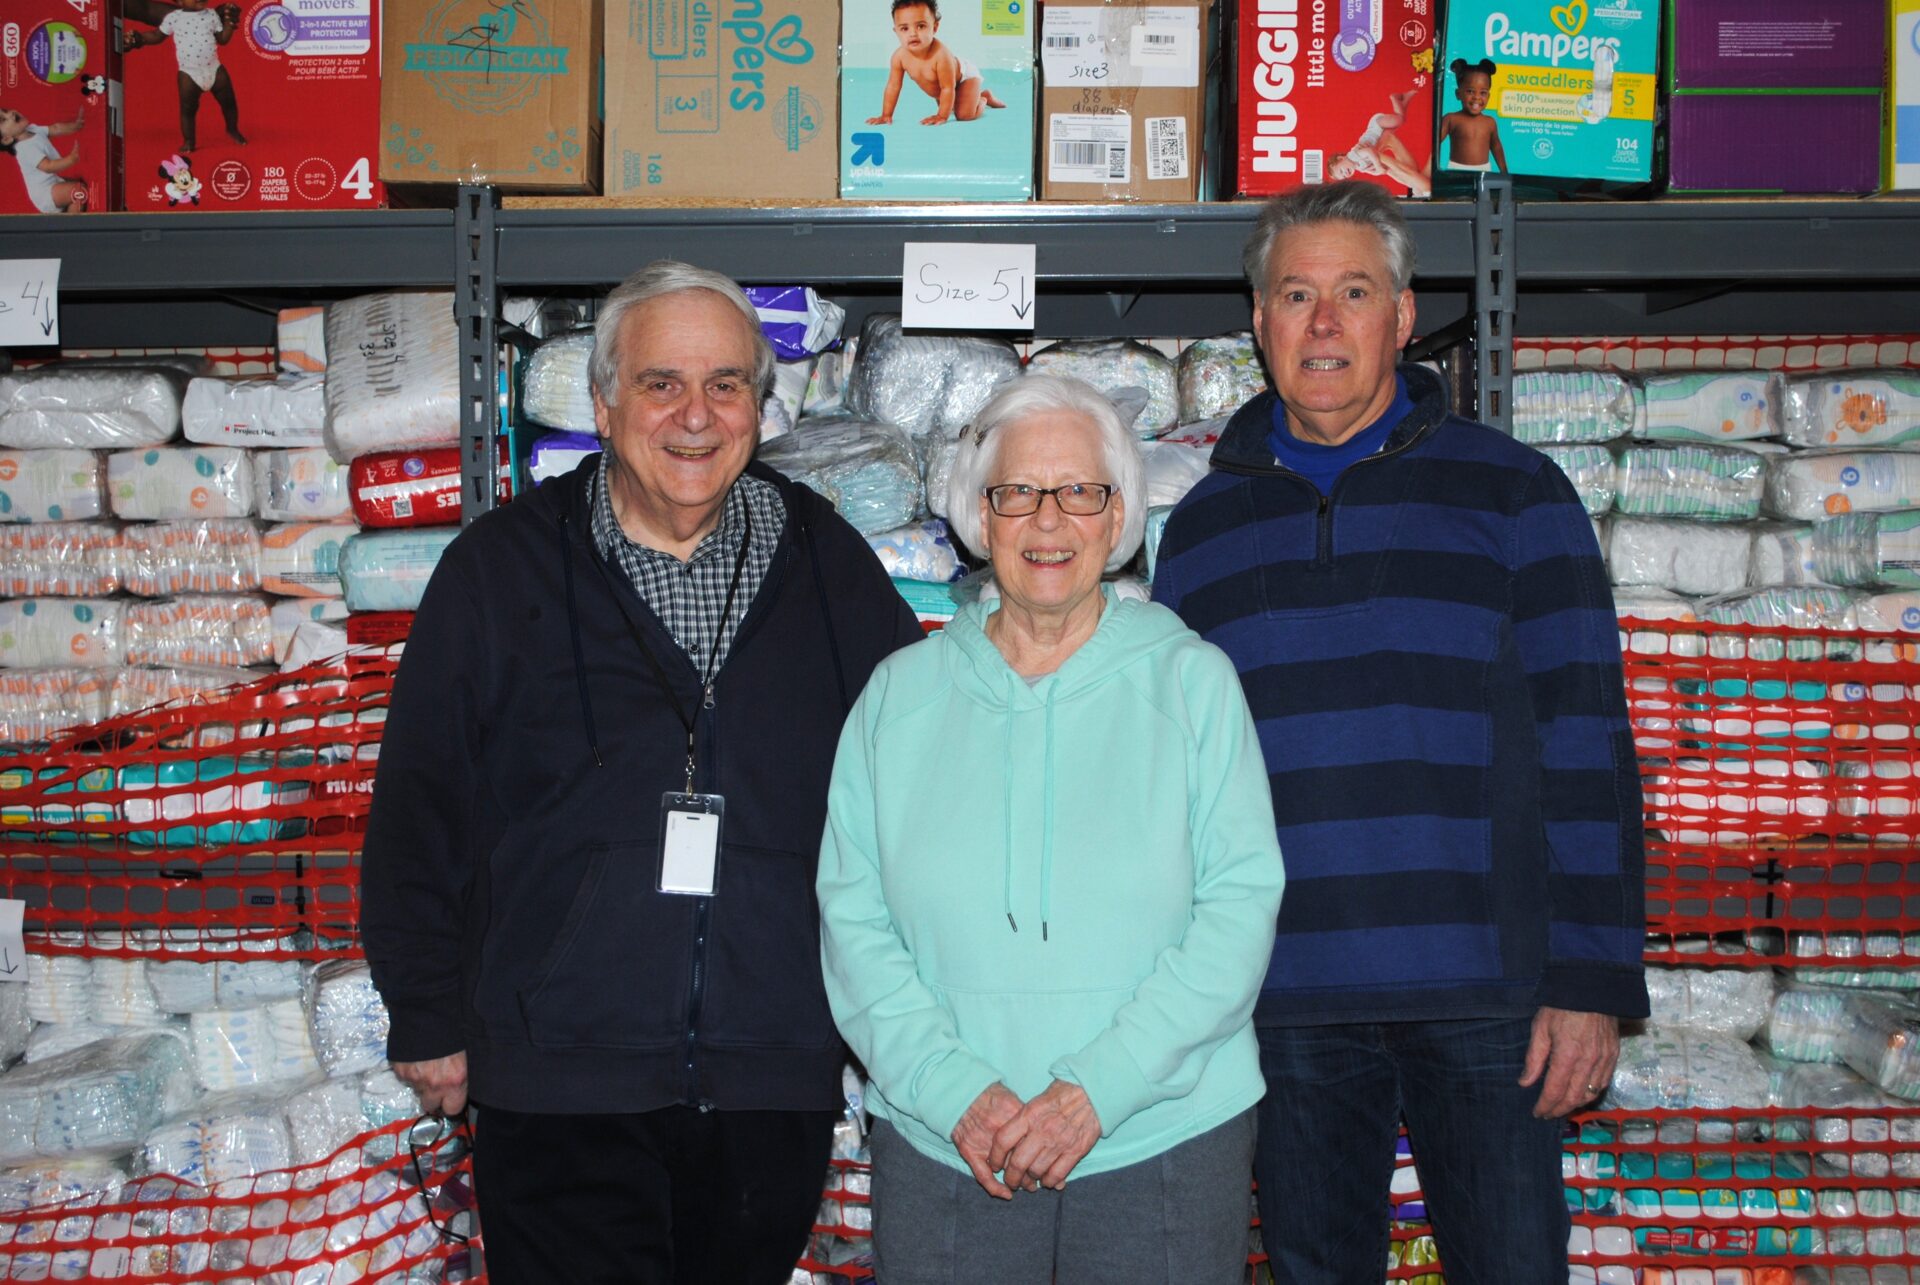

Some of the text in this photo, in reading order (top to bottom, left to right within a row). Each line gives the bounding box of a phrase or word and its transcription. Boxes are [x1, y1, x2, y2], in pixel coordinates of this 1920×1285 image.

[299, 0, 355, 10] movers
[300, 20, 320, 28] 2-in-1
[320, 20, 348, 28] ACTIVE
[6, 27, 17, 54] 360
[310, 30, 358, 38] PROTECTION
[1484, 12, 1620, 66] Pampers
[343, 58, 360, 66] dans
[414, 50, 559, 68] PEDIATRICIAN
[1306, 38, 1325, 88] little
[295, 67, 316, 75] POUR
[338, 66, 360, 74] ACTIF
[1507, 73, 1593, 90] swaddlers
[1082, 88, 1102, 102] 88
[1623, 90, 1635, 106] 5
[674, 96, 698, 112] 3
[1072, 102, 1116, 116] diapers
[1504, 104, 1574, 116] skin protection
[1512, 120, 1544, 128] protection
[1616, 138, 1638, 150] 104
[264, 166, 285, 177] 180
[648, 154, 662, 185] 168
[262, 178, 288, 186] DIAPERS
[340, 157, 374, 200] 4
[916, 263, 1018, 304] Size 5
[21, 280, 44, 316] 4
[746, 288, 756, 296] 24
[234, 428, 259, 436] Project
[384, 468, 397, 477] 22
